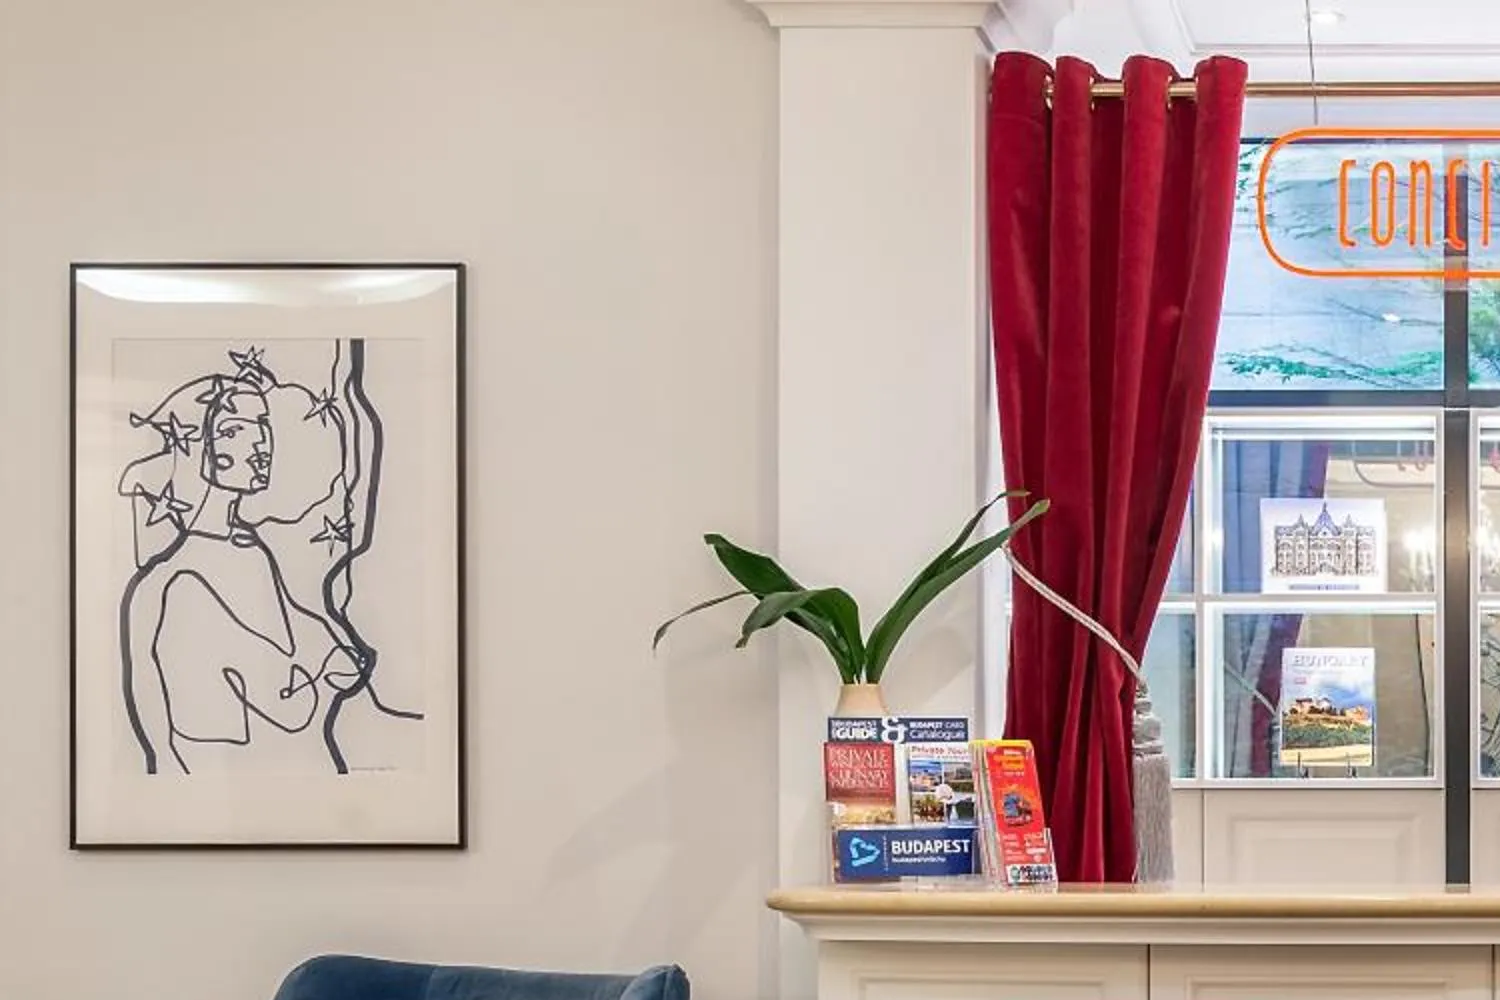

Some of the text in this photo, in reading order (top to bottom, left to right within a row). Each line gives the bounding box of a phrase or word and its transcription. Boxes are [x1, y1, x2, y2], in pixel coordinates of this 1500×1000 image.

[909, 721, 943, 729] BUDAPEST
[836, 728, 877, 739] GUIDE
[909, 729, 966, 741] Catalogue
[830, 748, 889, 763] PRIVATE
[891, 839, 970, 854] BUDAPEST
